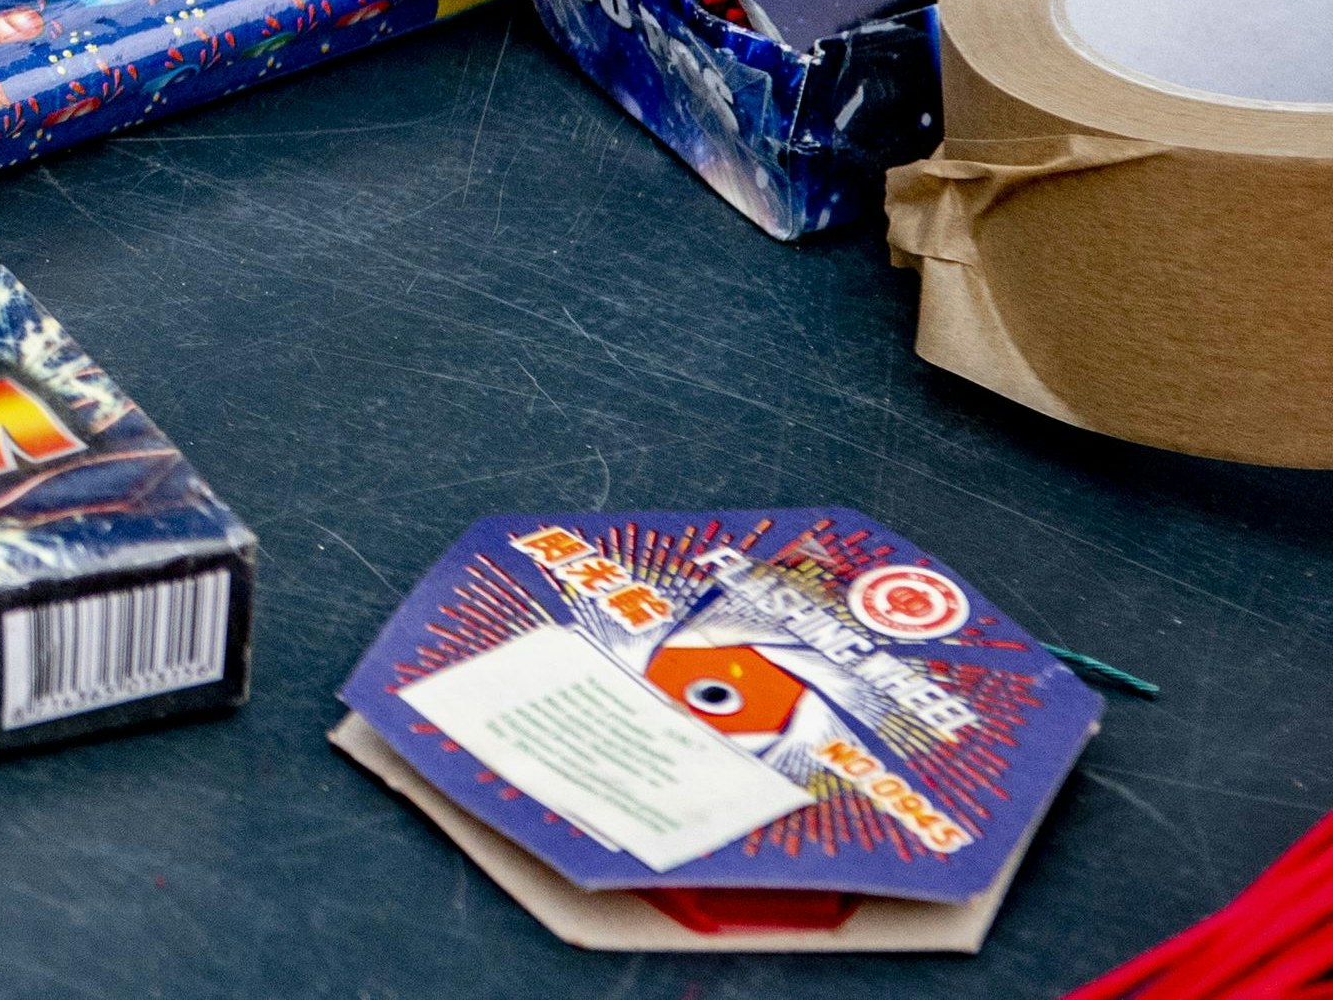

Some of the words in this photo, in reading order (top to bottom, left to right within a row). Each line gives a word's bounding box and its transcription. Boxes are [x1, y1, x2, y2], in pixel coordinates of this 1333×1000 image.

[695, 546, 877, 666] FLASHING
[863, 650, 980, 744] WHEEL
[869, 772, 976, 854] 0945
